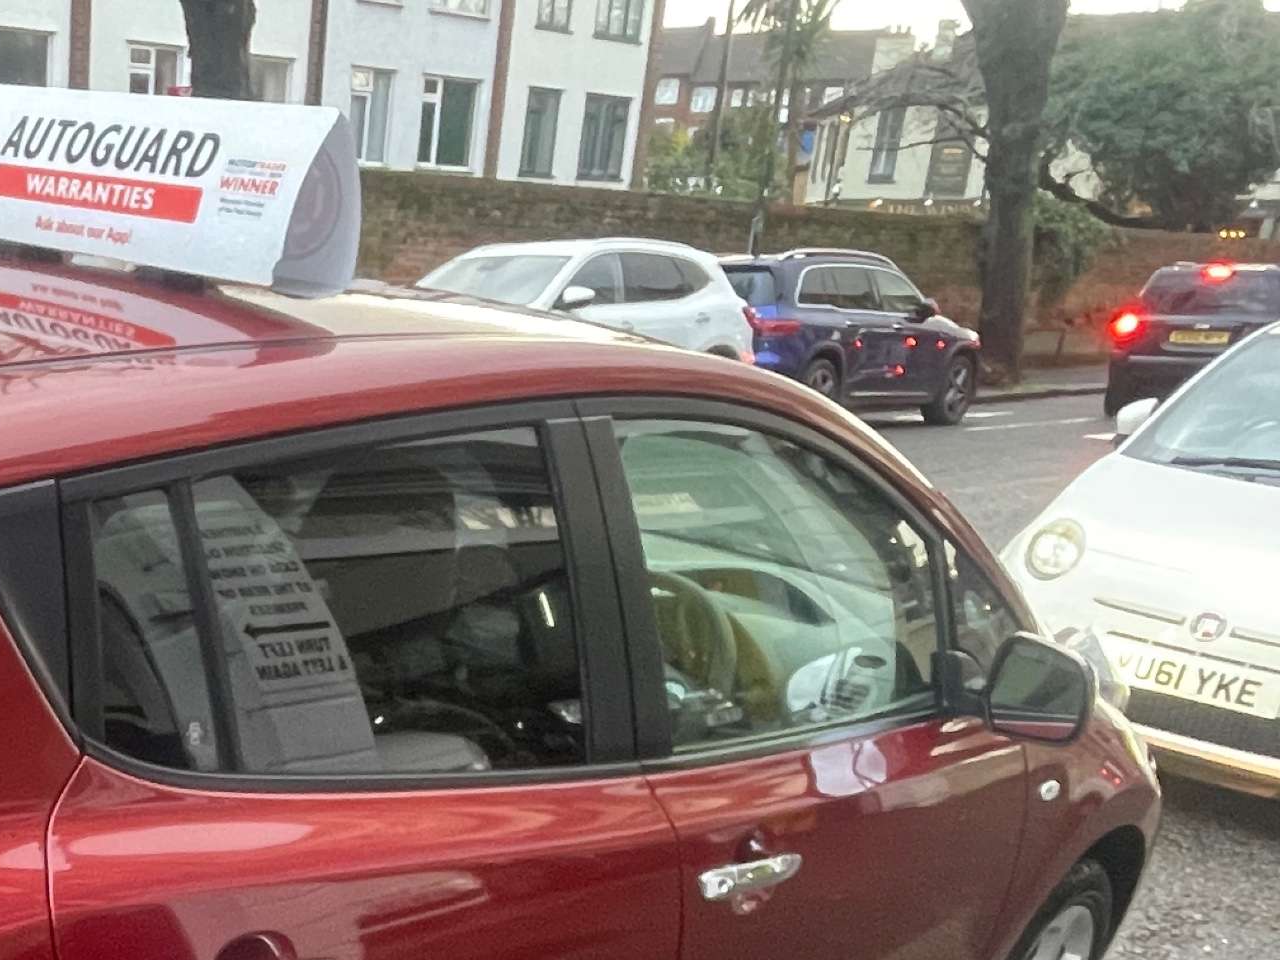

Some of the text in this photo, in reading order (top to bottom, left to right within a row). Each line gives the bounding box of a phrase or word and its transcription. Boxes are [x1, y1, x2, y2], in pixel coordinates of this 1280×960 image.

[1, 116, 220, 177] AUTOGUARD
[26, 173, 154, 210] WARRANTIES
[220, 176, 280, 195] WINNER
[1197, 668, 1263, 707] YKE
